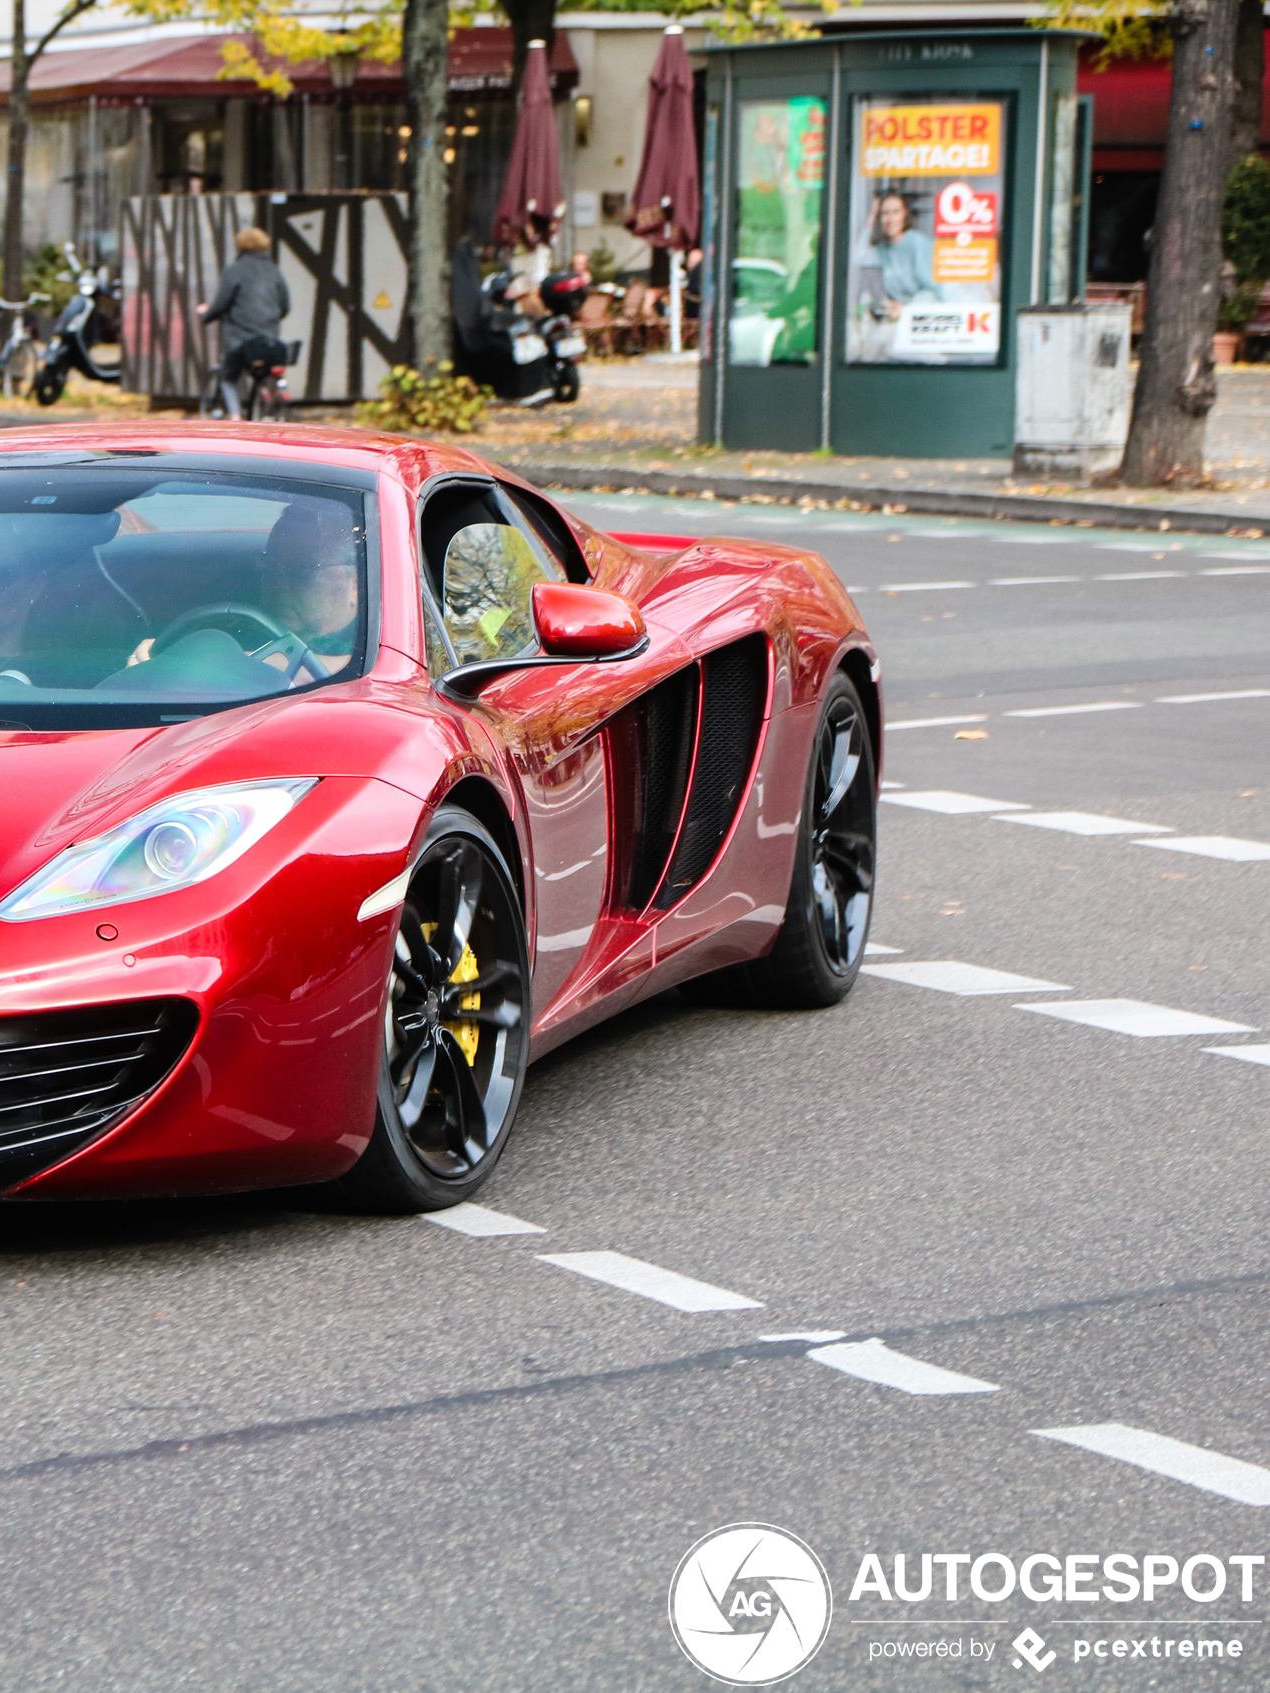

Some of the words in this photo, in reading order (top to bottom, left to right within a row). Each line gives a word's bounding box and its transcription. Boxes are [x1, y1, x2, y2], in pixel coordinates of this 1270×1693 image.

[865, 114, 990, 143] POLSTER
[864, 144, 990, 170] SPARTAGE!
[938, 181, 994, 225] 0%
